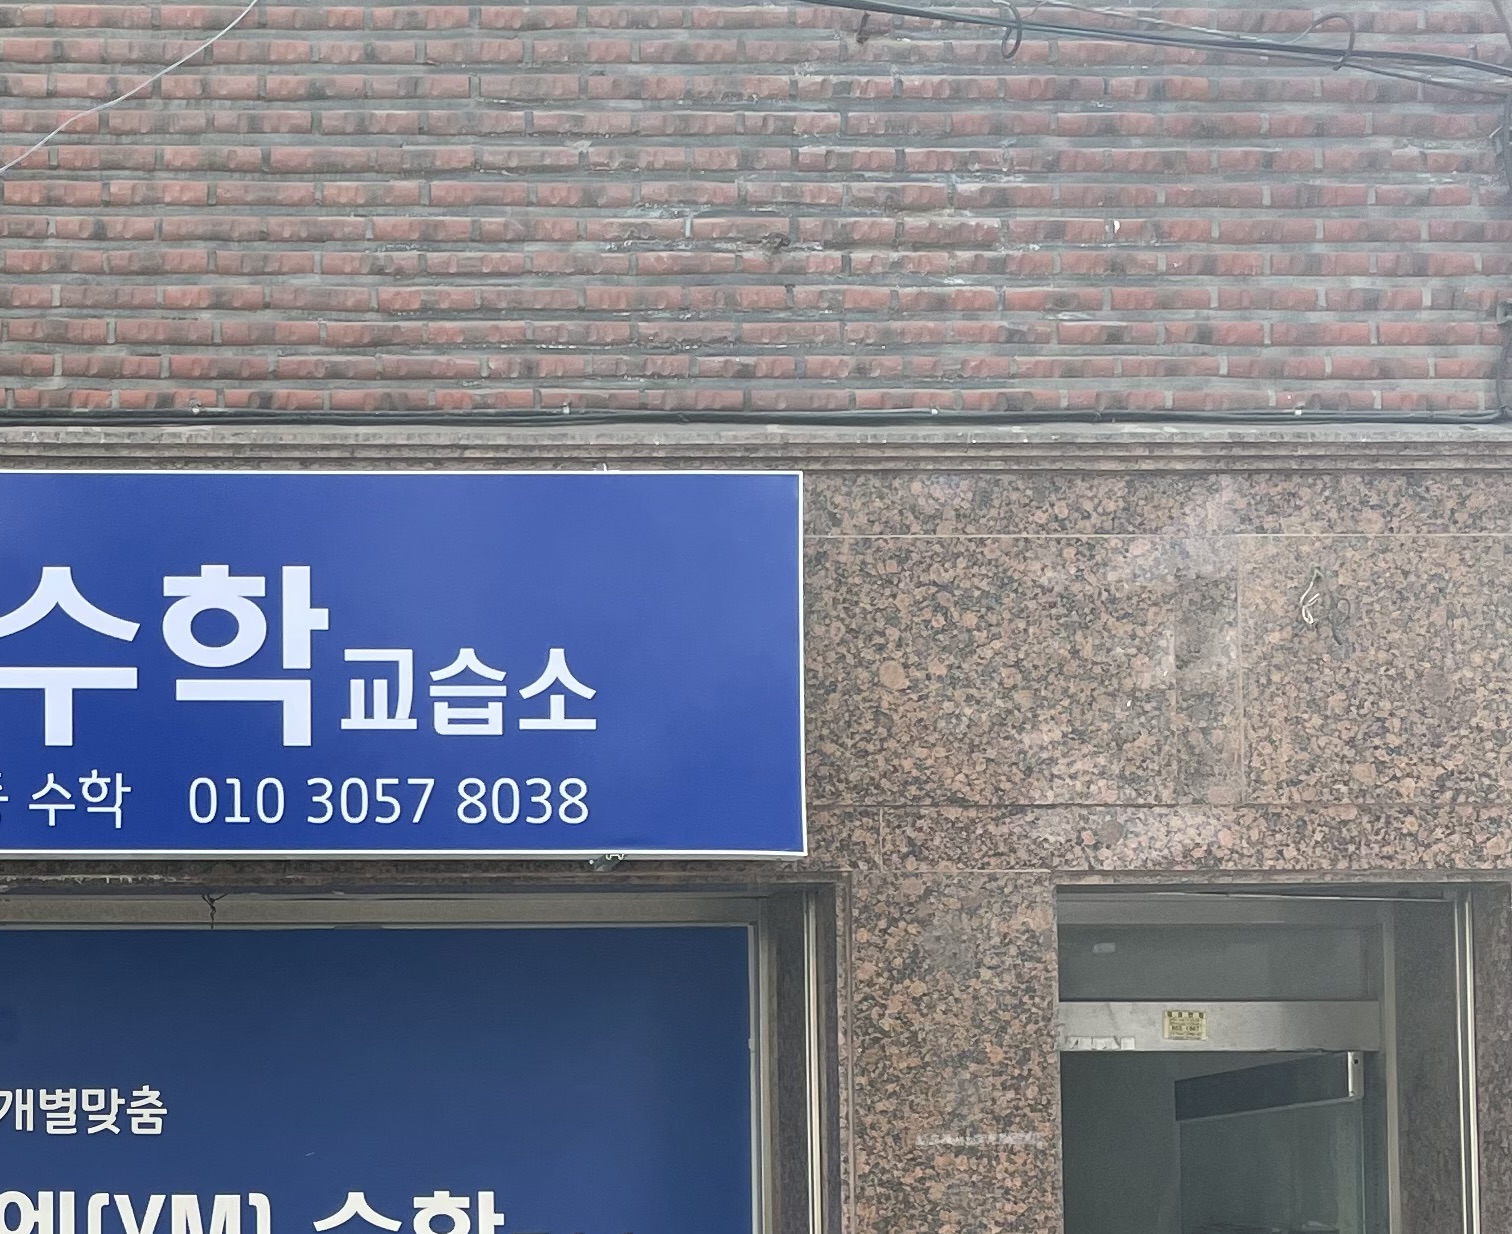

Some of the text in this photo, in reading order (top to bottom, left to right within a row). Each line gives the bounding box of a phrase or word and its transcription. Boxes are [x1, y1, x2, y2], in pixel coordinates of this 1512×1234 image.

[28, 769, 132, 829] 수학
[189, 777, 285, 824] 010
[307, 777, 435, 824] 3057
[457, 777, 589, 824] 8038
